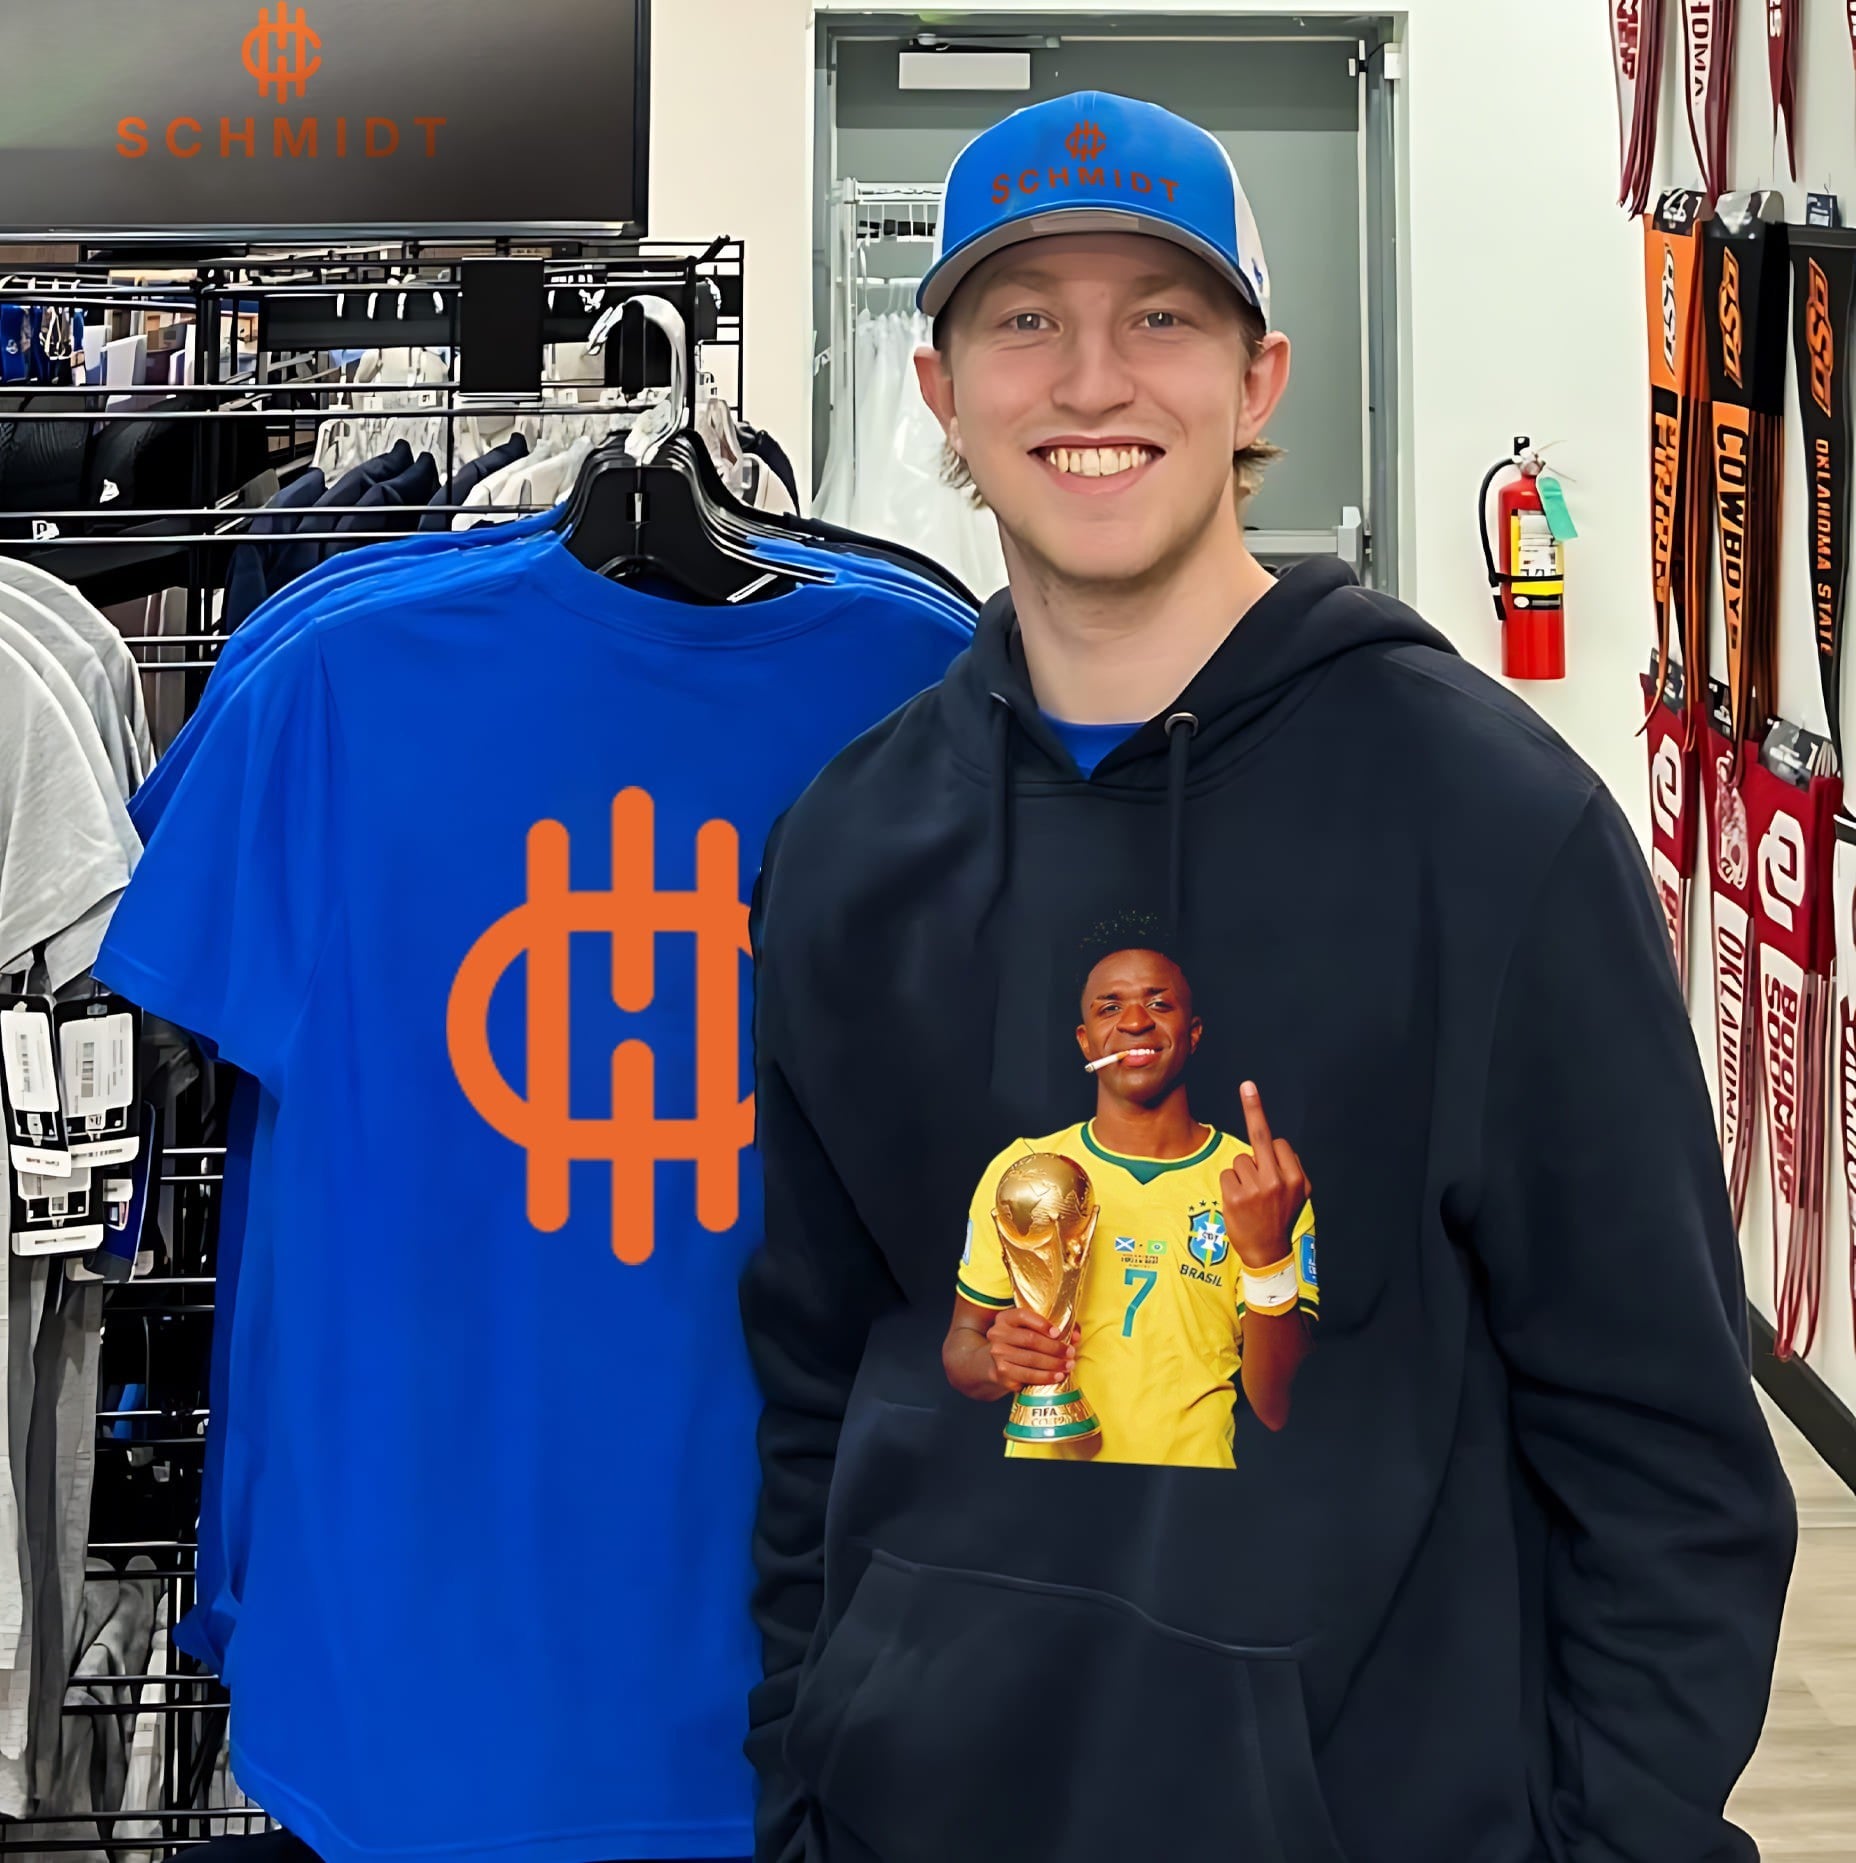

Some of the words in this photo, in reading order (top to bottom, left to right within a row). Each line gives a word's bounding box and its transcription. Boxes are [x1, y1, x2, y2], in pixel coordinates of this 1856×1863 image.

[116, 117, 447, 159] SCHMIDT
[992, 167, 1178, 204] SCHMIDT
[1815, 438, 1832, 570] OKLAHOMA
[1817, 583, 1834, 656] STATE
[1180, 1264, 1222, 1287] BRASIL
[1122, 1268, 1157, 1338] 7
[1032, 1407, 1058, 1417] FIFA
